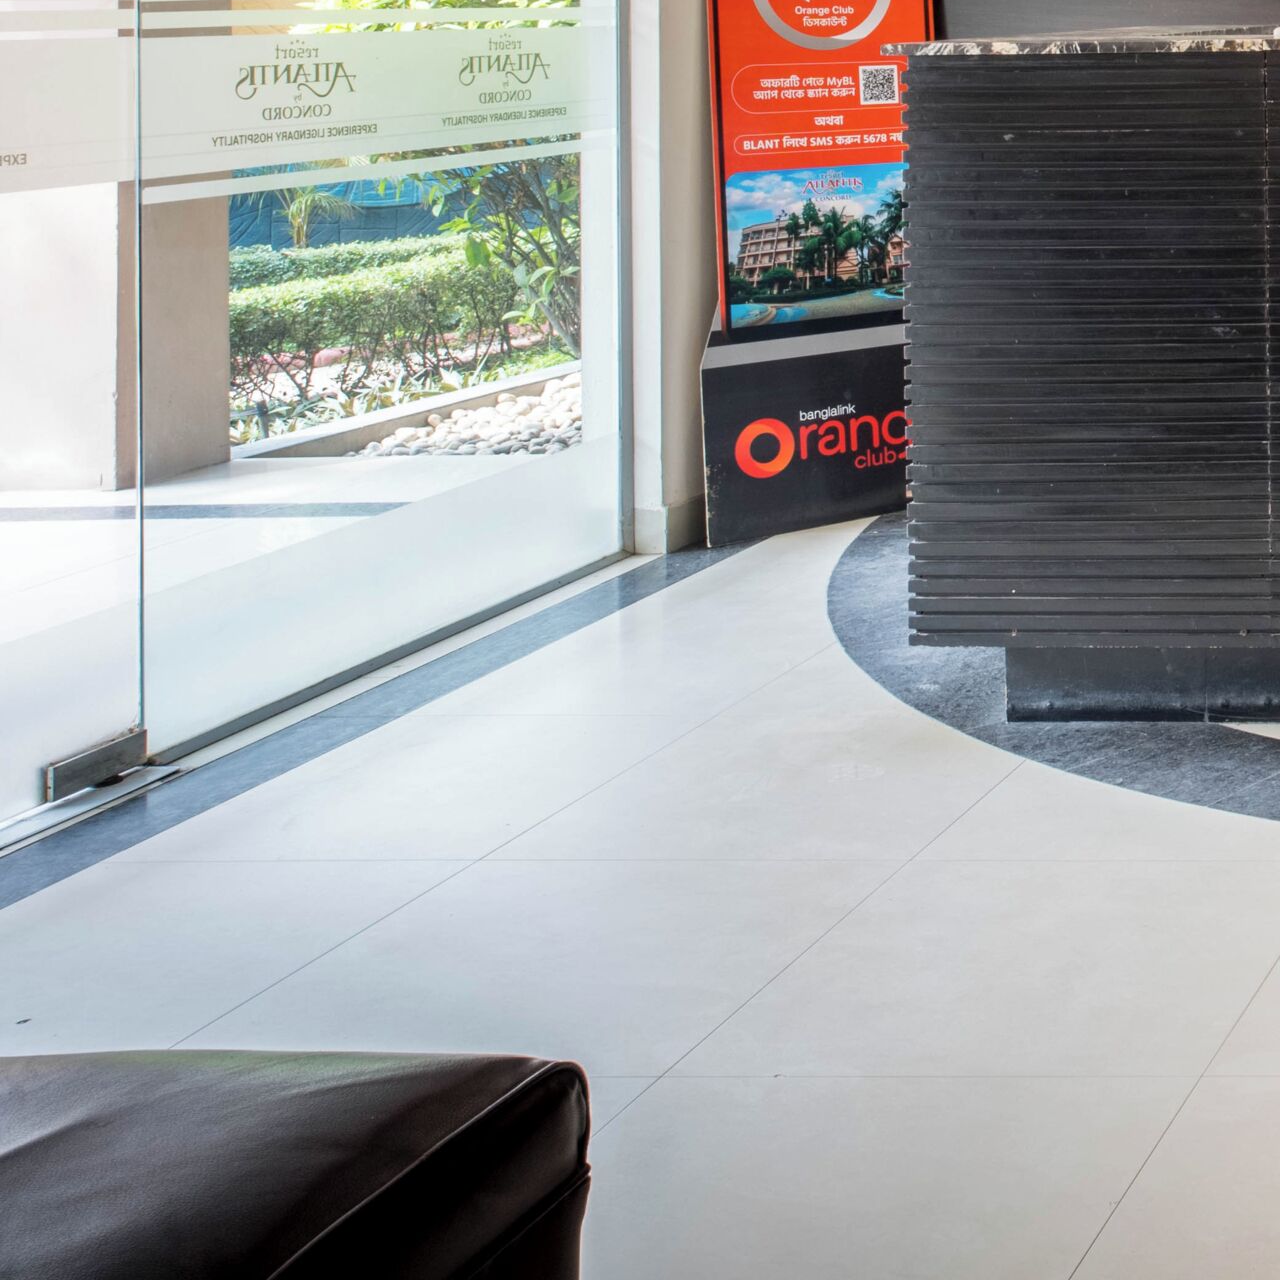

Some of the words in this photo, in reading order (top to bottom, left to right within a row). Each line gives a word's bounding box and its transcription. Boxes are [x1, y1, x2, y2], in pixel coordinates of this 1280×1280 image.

[794, 5, 830, 17] Orange
[831, 5, 855, 15] Club
[826, 76, 855, 87] MyBL
[814, 115, 844, 126] অথবা
[743, 139, 780, 151] BLANT
[810, 136, 833, 147] SMS
[863, 133, 887, 144] 5678
[799, 403, 857, 422] banglalink
[854, 446, 897, 469] club
